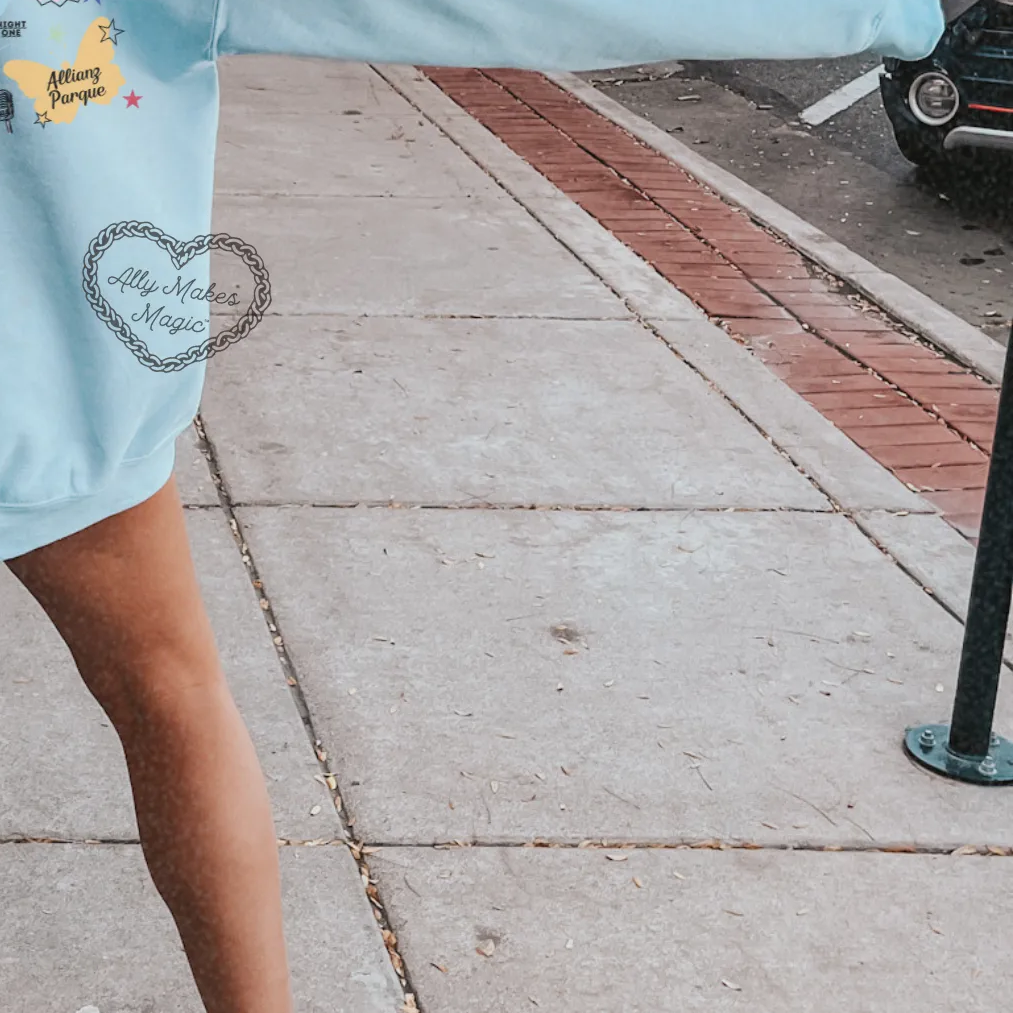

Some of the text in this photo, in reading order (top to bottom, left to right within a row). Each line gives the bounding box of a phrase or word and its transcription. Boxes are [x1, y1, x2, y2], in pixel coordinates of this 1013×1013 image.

[0, 29, 22, 38] ONE
[46, 67, 102, 92] Allianz
[48, 86, 106, 109] Parque
